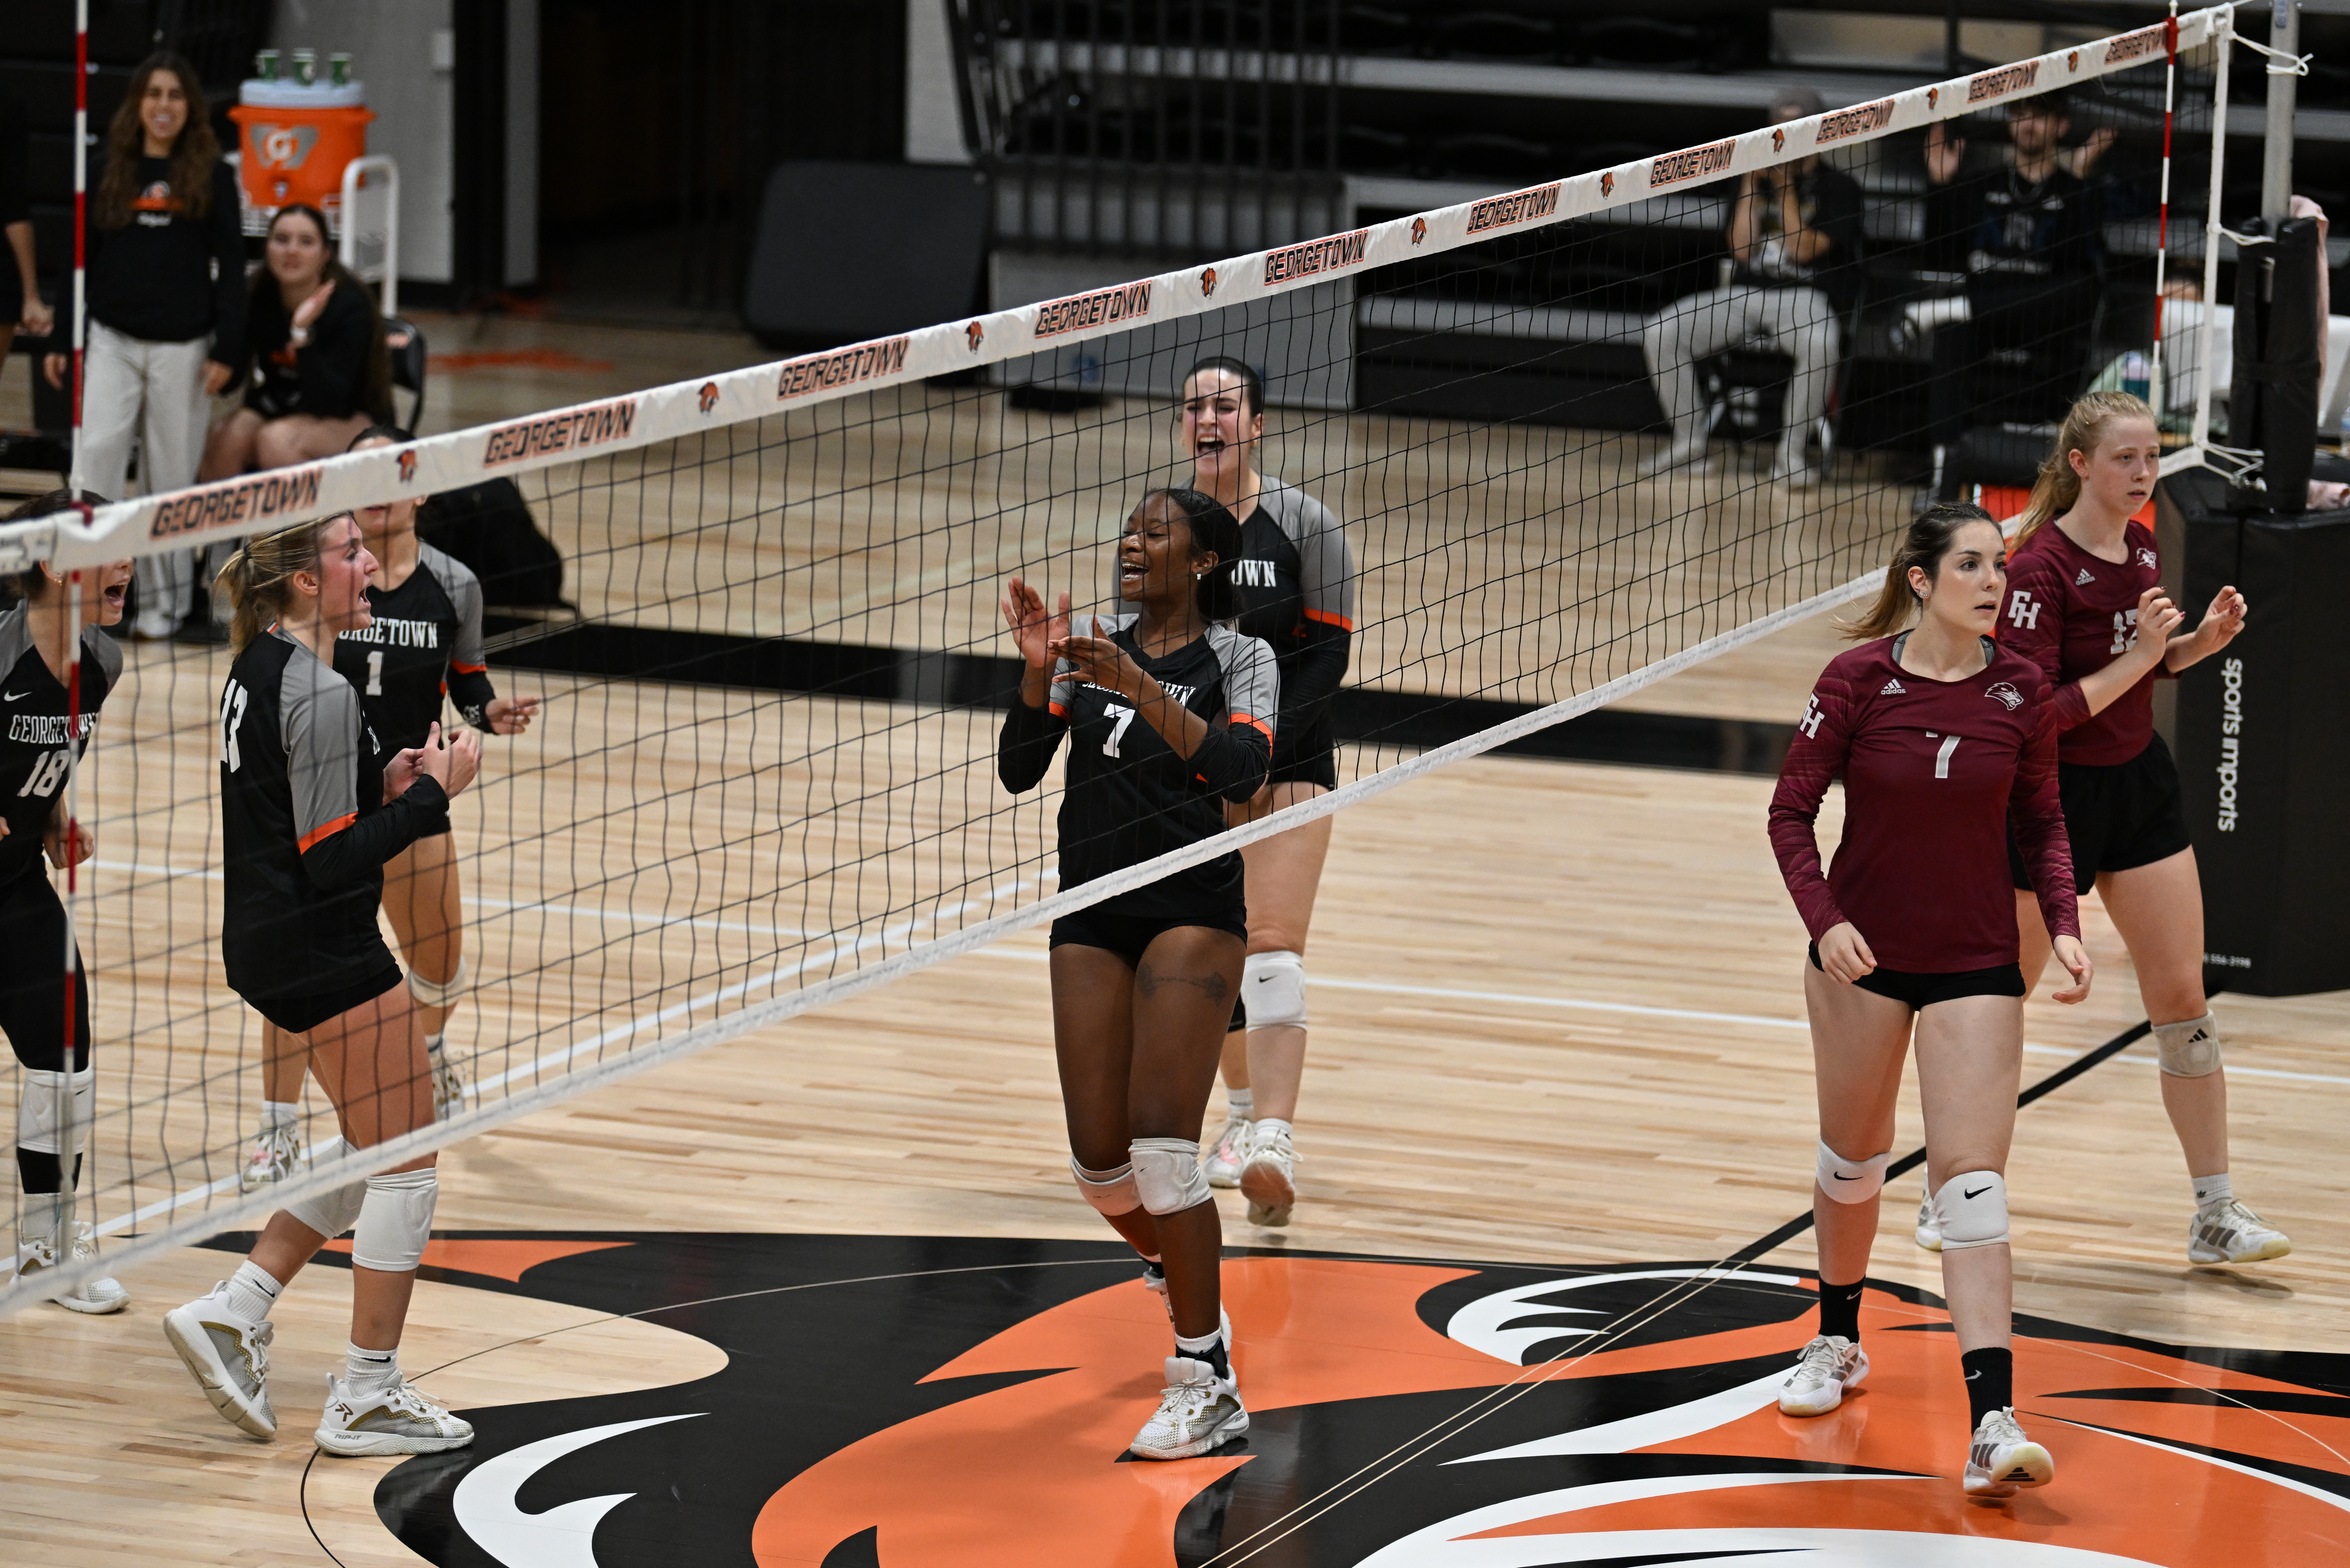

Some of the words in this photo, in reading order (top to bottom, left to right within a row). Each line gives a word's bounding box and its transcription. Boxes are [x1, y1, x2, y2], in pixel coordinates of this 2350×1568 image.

[1816, 98, 1895, 144] GEORGETOWN
[1650, 139, 1736, 188] GEORGETOWN
[1466, 183, 1561, 235] GEORGETOWN
[1264, 230, 1368, 287] GEORGETOWN
[1033, 280, 1152, 339] GEORGETOWN
[777, 336, 910, 401] GEORGETOWN
[483, 399, 636, 469] GEORGETOWN
[149, 467, 323, 541] GEORGETOWN
[2008, 590, 2041, 630] FH
[366, 650, 384, 696] 1
[1880, 687, 1906, 695] adidas
[2221, 657, 2243, 735] sports
[1103, 703, 1136, 759] 7
[1926, 731, 1962, 779] 7
[17, 749, 71, 798] 18
[2216, 737, 2240, 832] imports
